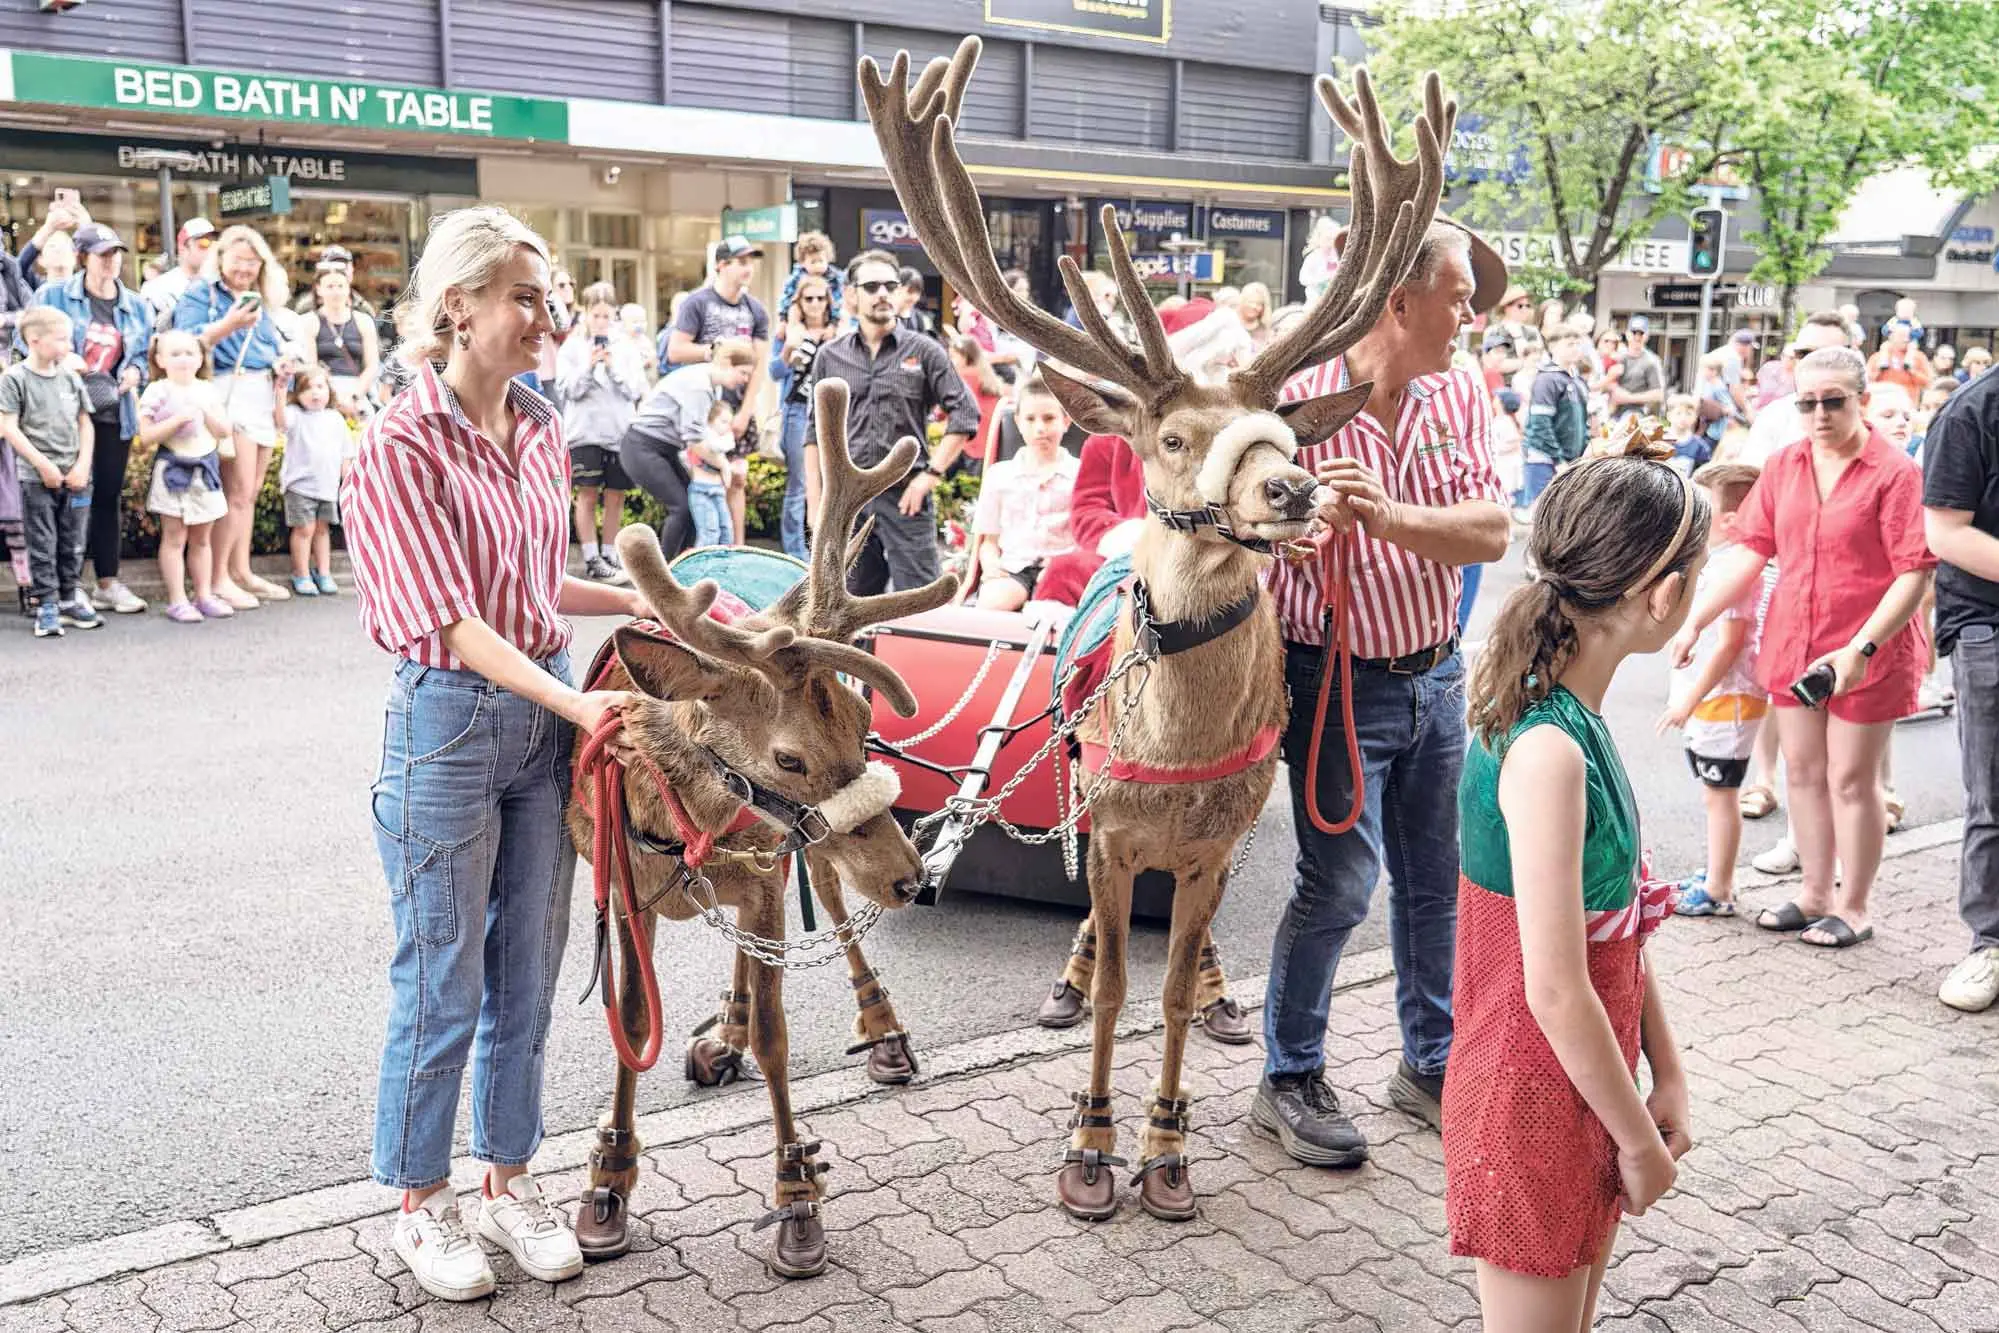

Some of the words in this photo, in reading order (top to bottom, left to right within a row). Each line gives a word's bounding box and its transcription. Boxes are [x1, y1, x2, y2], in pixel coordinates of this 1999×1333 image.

[113, 68, 203, 108] BED
[213, 75, 320, 118] BATH
[330, 85, 365, 121] N'
[376, 90, 493, 131] TABLE
[272, 156, 346, 181] TABLE
[1134, 207, 1188, 232] Supplies
[1211, 211, 1272, 233] Costumes
